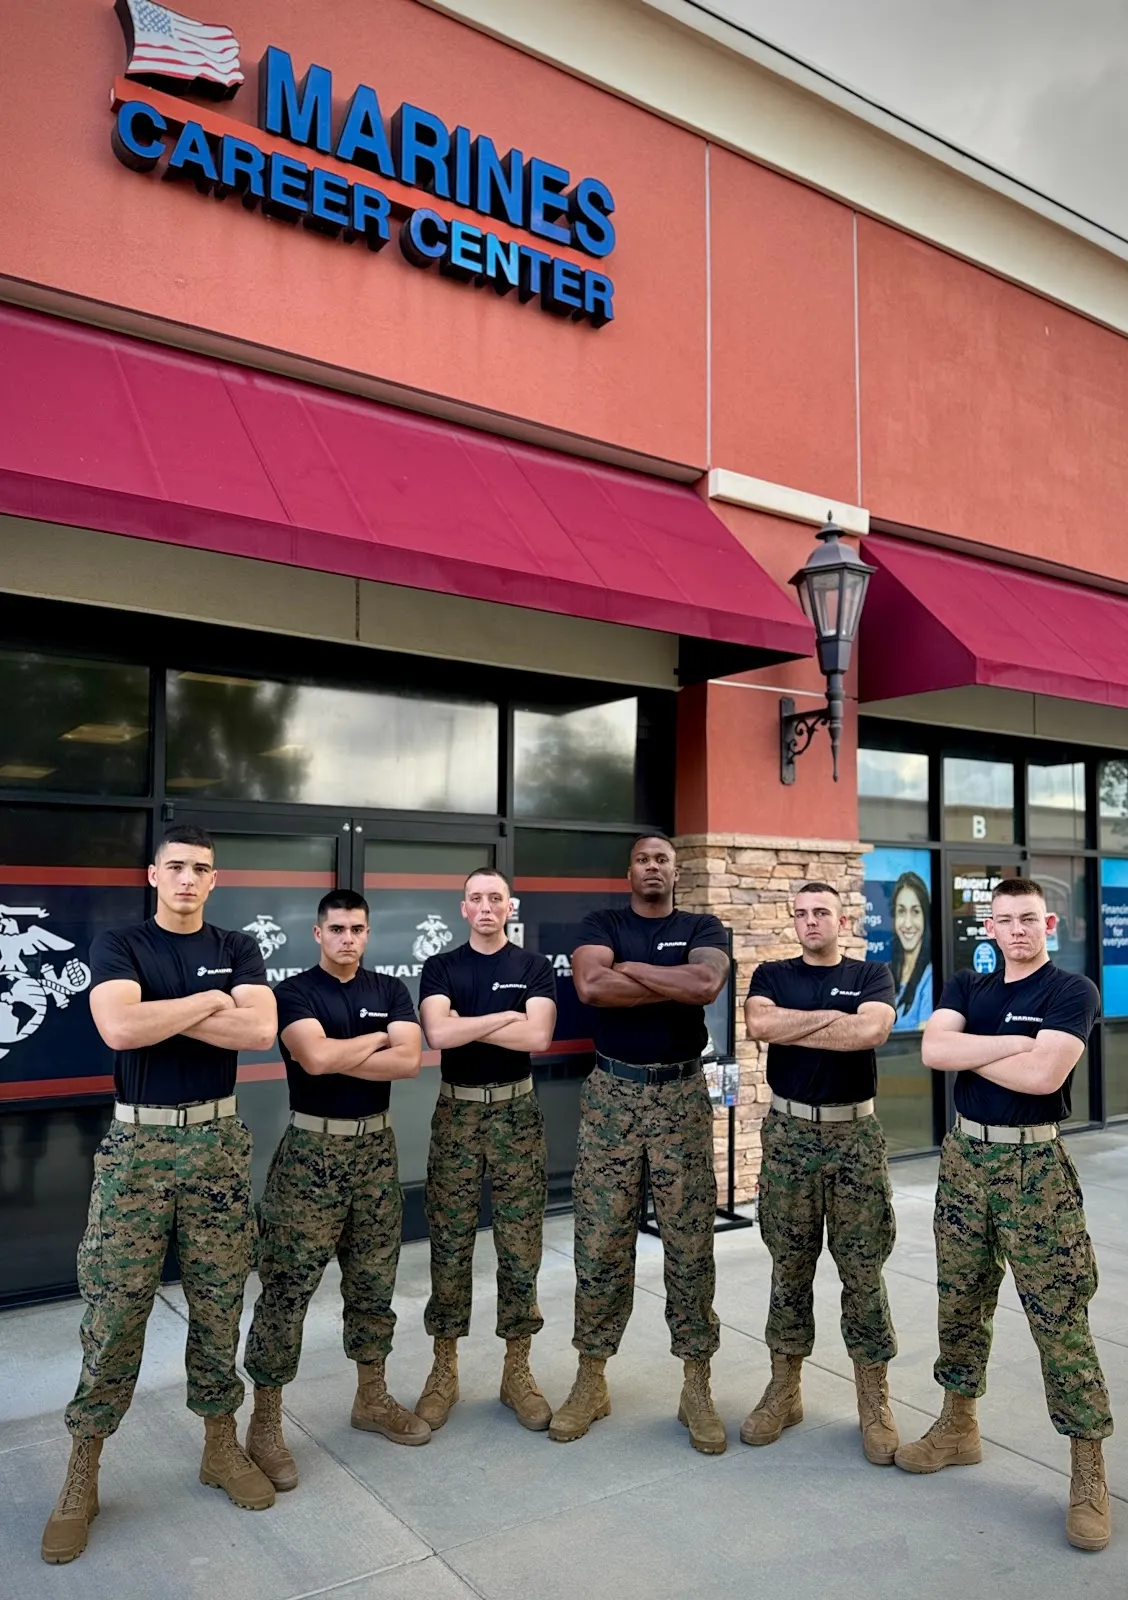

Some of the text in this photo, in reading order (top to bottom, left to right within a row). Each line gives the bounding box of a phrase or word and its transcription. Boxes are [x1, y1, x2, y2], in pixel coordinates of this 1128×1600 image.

[116, 100, 616, 323] CAREER CENTER
[263, 45, 616, 258] MARINES
[972, 815, 987, 839] B
